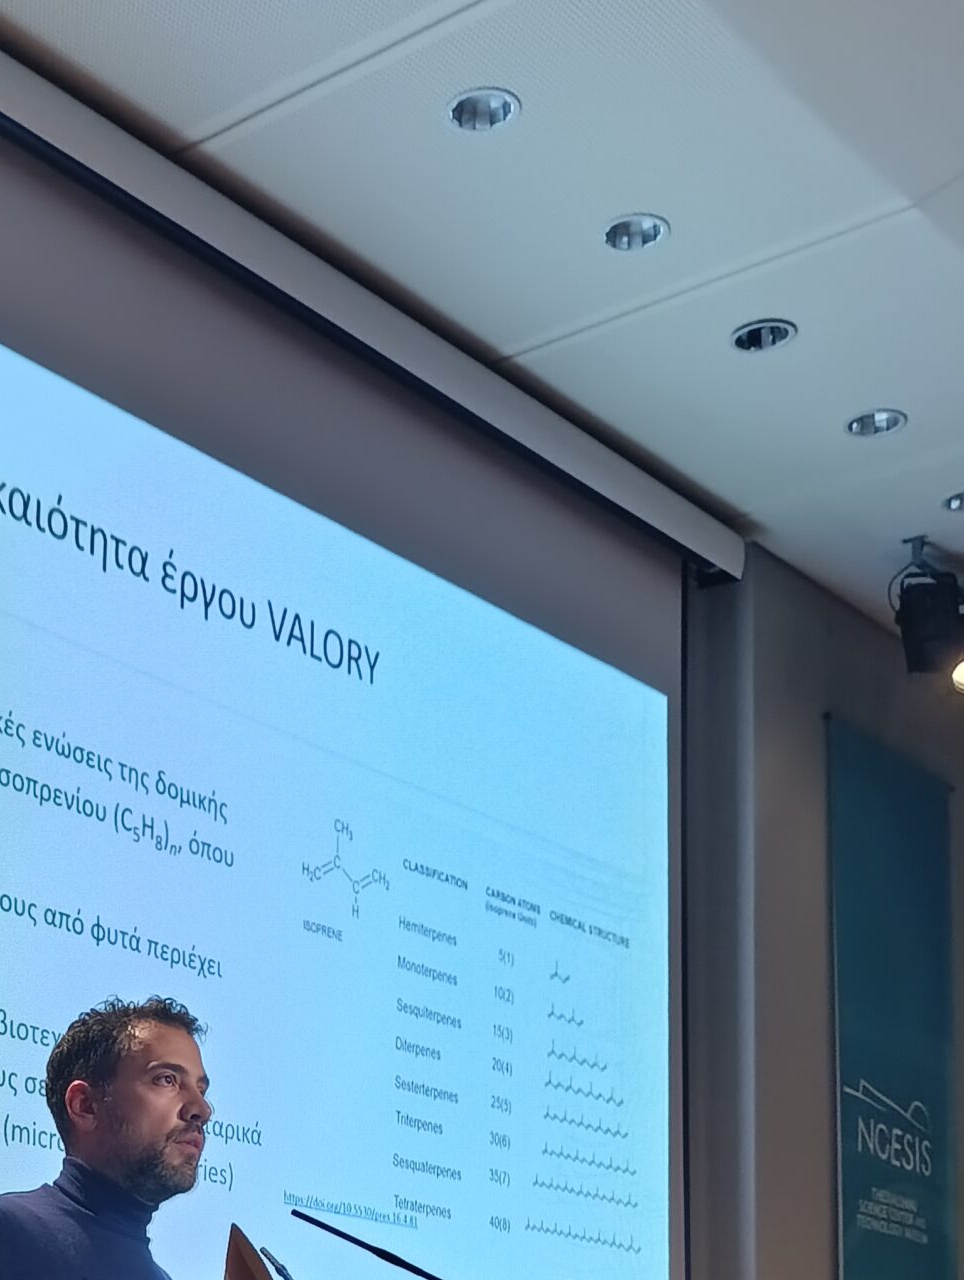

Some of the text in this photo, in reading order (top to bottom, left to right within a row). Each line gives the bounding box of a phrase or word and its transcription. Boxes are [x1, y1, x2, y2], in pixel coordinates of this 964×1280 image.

[161, 548, 257, 629] έργου
[268, 600, 380, 685] VALORY
[32, 723, 113, 782] ενώσεις
[117, 757, 150, 794] της
[155, 763, 229, 823] δομικής
[189, 828, 235, 867] όπου
[402, 858, 468, 891] CLASSIFICATION
[485, 886, 516, 906] CARBON
[303, 919, 343, 942] ISOPRENE
[398, 915, 457, 947] Hemiterpenes
[549, 909, 586, 933] CHEMICAL
[43, 904, 84, 936] από
[90, 916, 141, 954] φυτά
[147, 937, 222, 978] περιέχει
[397, 954, 458, 986] Monoterpenes
[396, 997, 462, 1030] Sesquiterpenes
[395, 1035, 441, 1061] Diterpenes
[394, 1074, 459, 1104] Sesterterpenes
[204, 1119, 262, 1147] ταρικά
[395, 1109, 443, 1135] Triterpenes
[198, 1159, 233, 1192] ries)
[394, 1194, 452, 1220] Tetraterpenes
